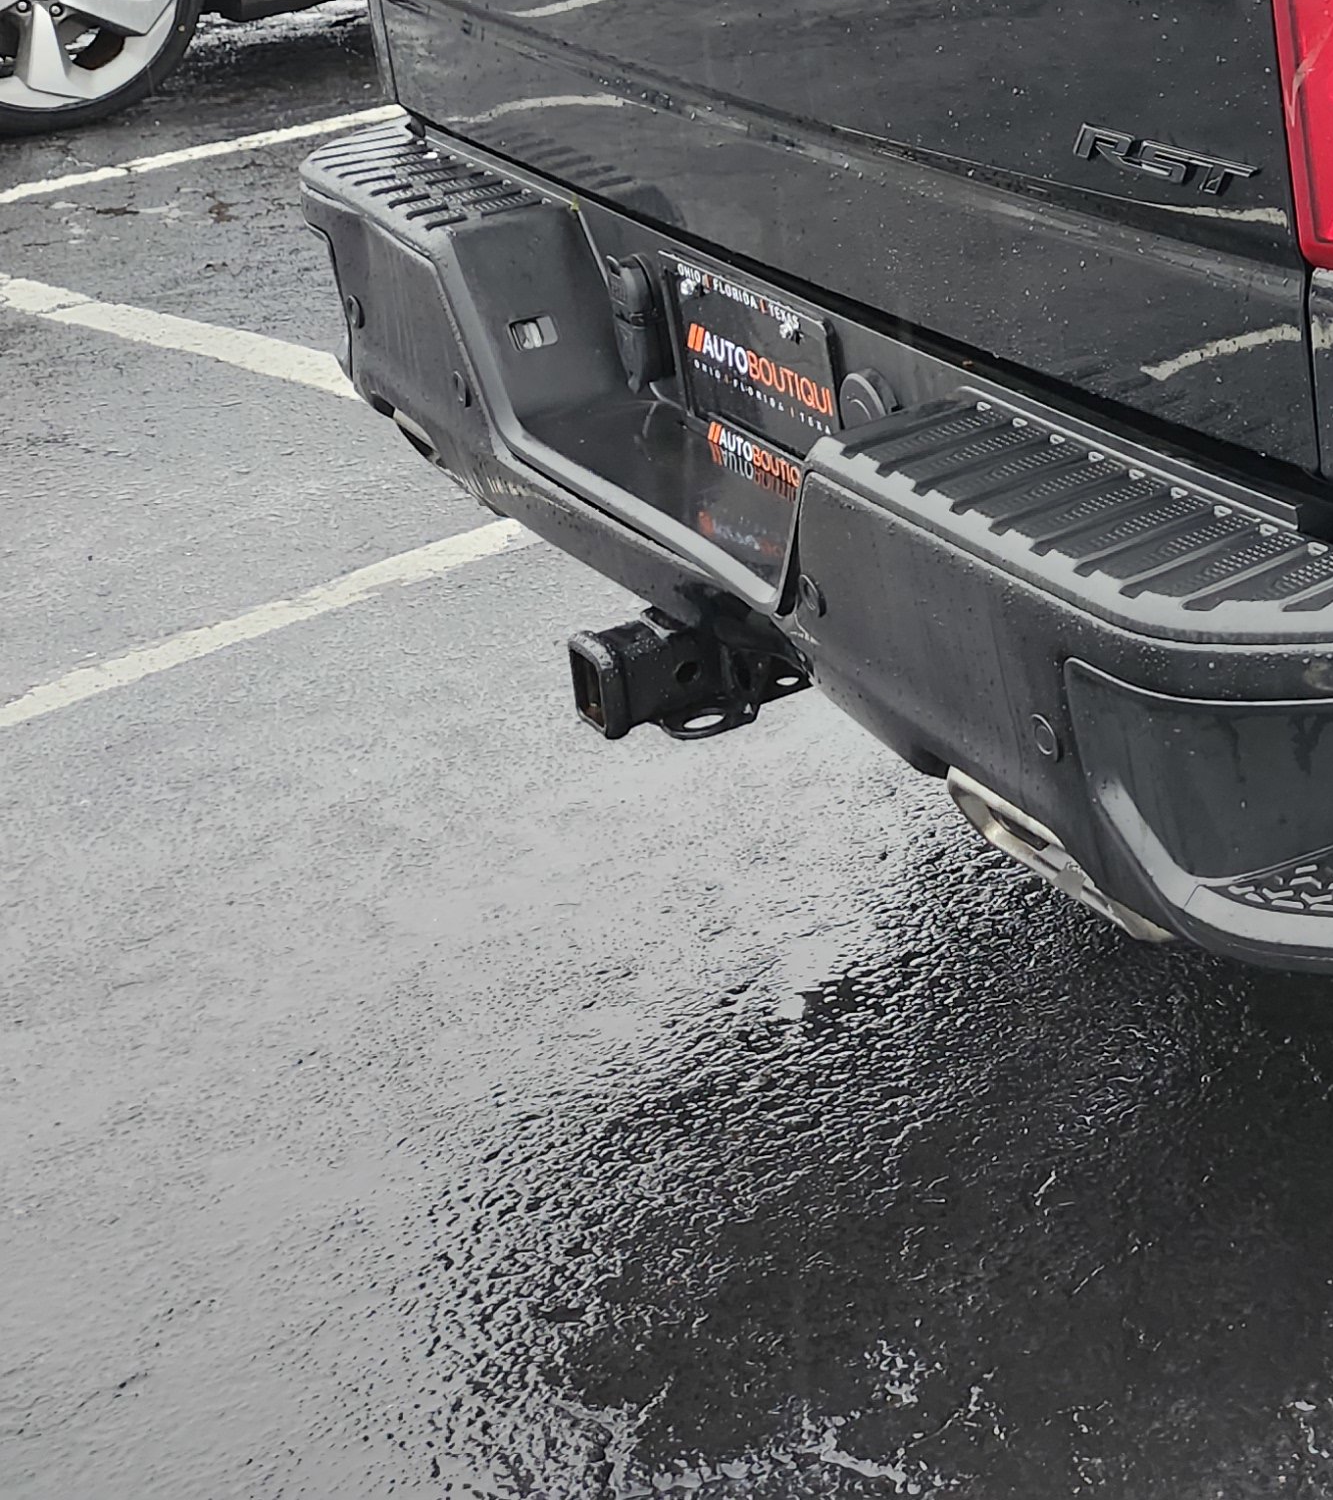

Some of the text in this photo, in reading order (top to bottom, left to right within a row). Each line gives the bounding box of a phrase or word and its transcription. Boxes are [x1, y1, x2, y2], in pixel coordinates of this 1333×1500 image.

[1072, 122, 1259, 195] RST
[677, 263, 799, 329] OHIO FLORIDA TEXAS
[799, 412, 831, 435] TEXA
[719, 428, 800, 488] AUTOBOUTIQ
